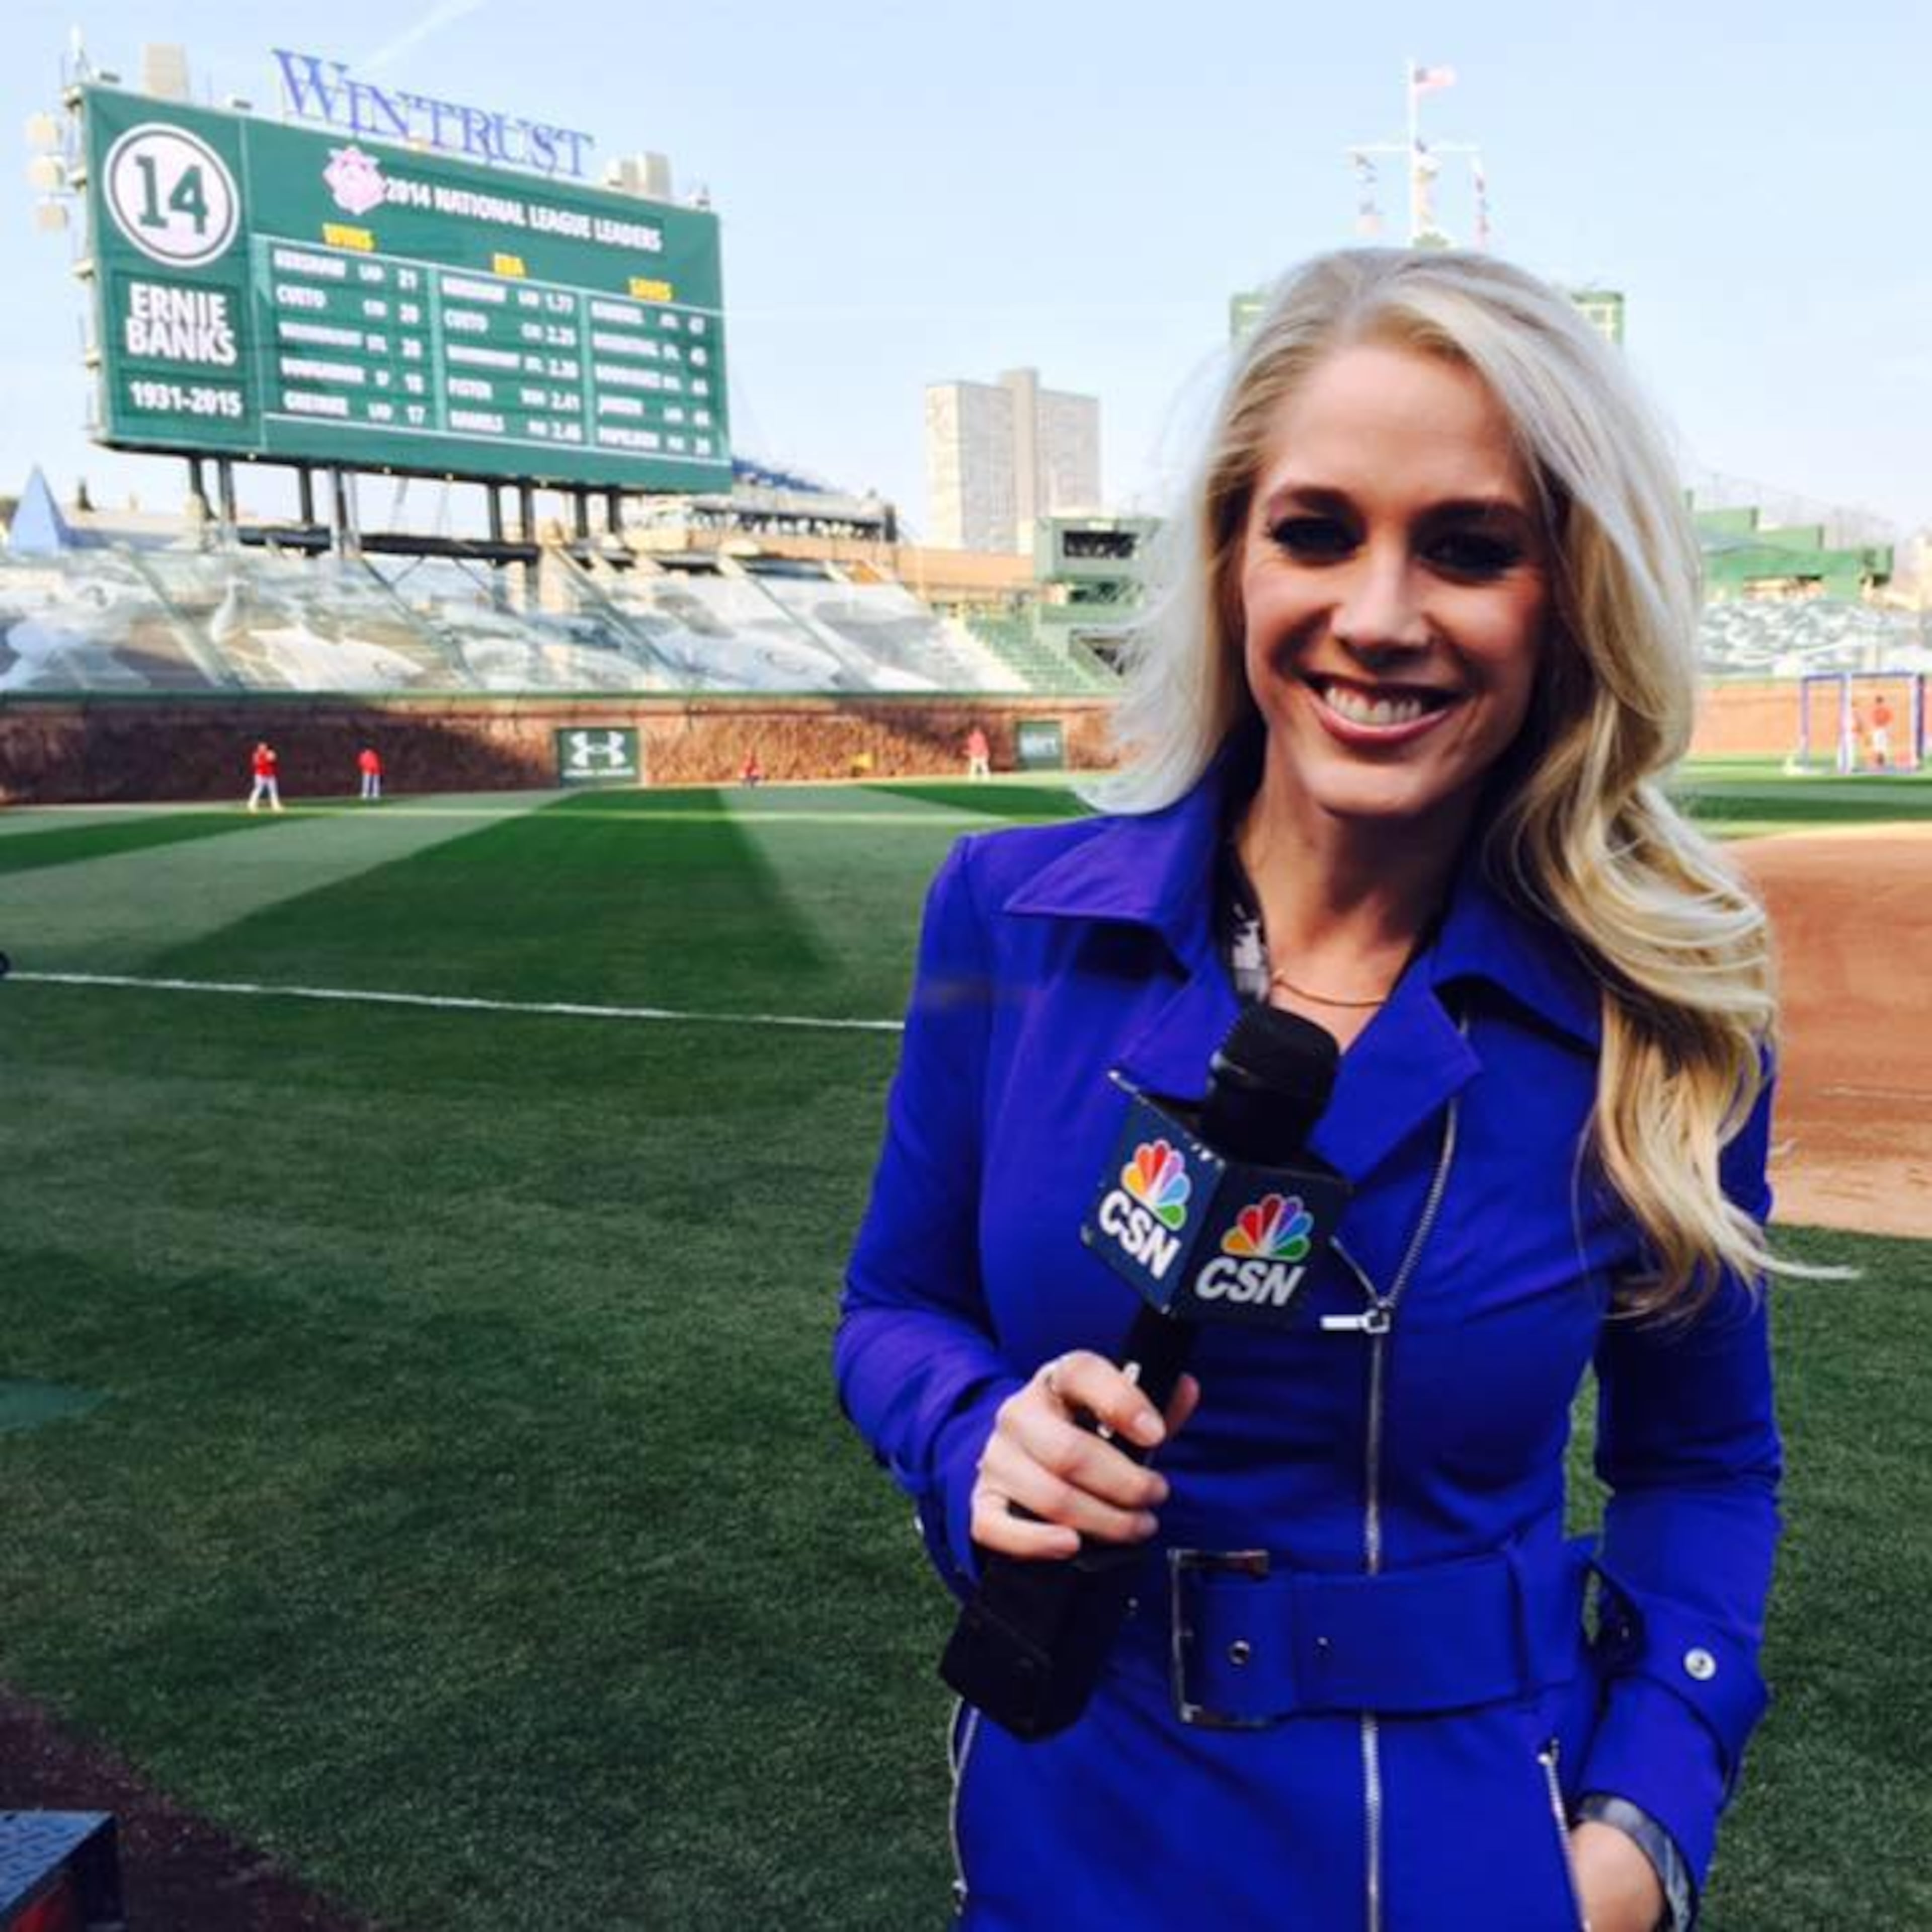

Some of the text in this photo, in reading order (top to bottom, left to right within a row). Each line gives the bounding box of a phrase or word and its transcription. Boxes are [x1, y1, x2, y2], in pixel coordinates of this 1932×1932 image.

[272, 49, 595, 178] WINTRUST
[134, 154, 209, 236] 14
[386, 177, 662, 252] 2014 NATIONAL LEAGUE LEADERS
[130, 282, 226, 327] ERNIE
[125, 316, 237, 367] BANKS
[130, 381, 243, 417] 1931-2015
[1099, 1190, 1180, 1279] CSN
[1195, 1257, 1307, 1306] CSN
